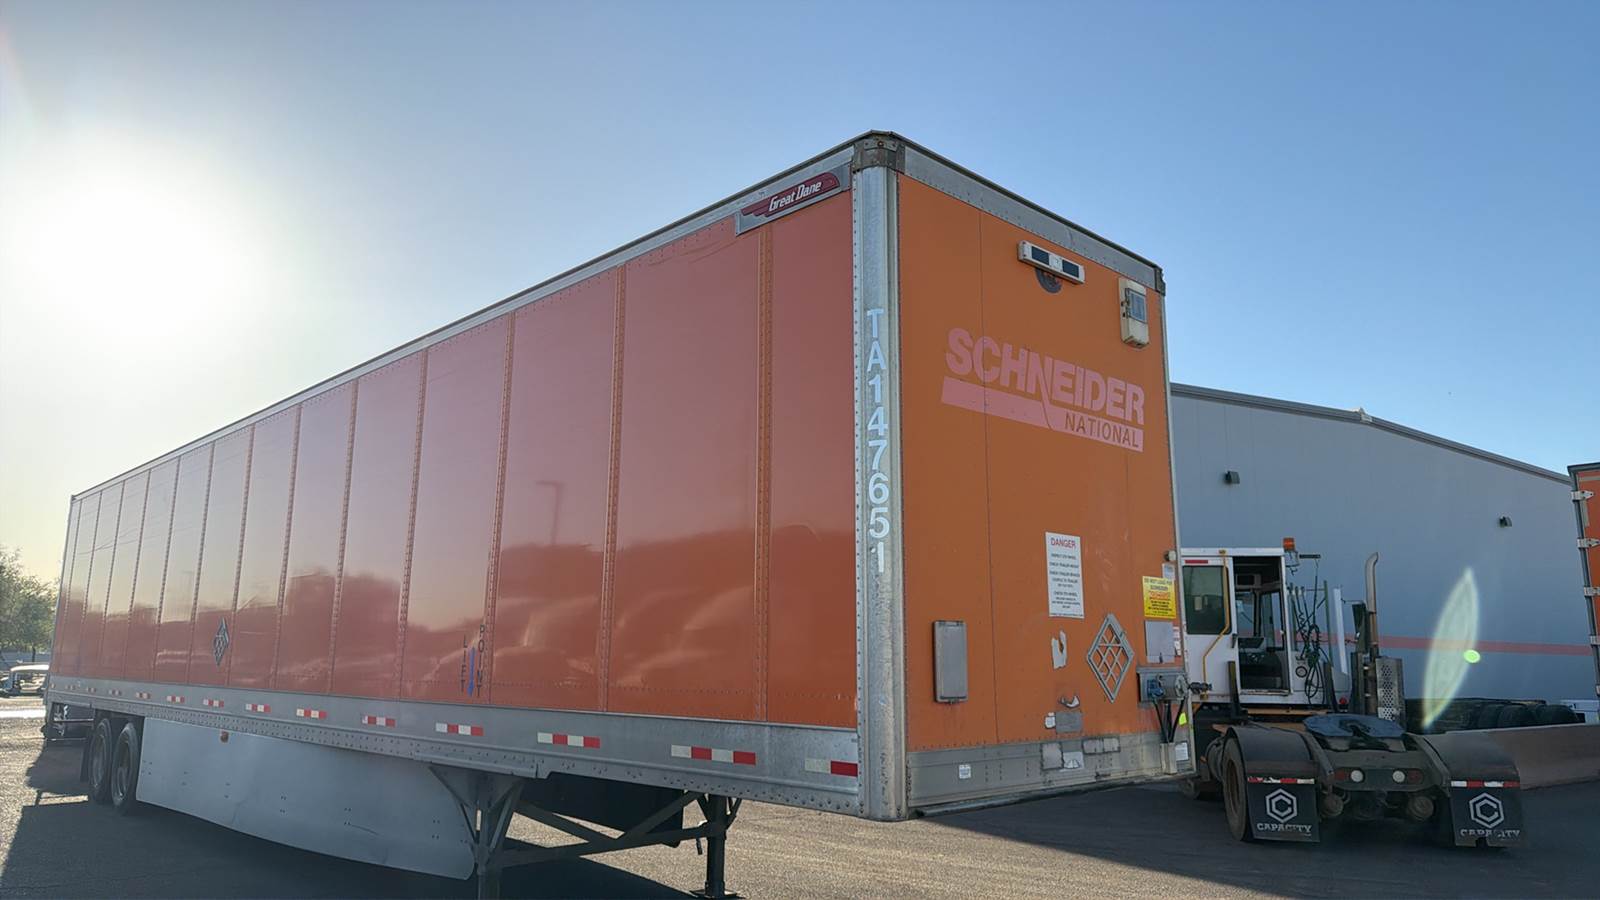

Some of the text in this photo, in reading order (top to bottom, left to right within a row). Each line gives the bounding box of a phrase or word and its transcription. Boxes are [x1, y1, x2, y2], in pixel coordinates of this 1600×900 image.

[768, 182, 822, 212] Great Dane
[945, 327, 1145, 426] SCHNEIDER
[866, 308, 890, 573] TA147651
[1064, 413, 1140, 448] NATIONAL
[1050, 537, 1077, 549] DANGER
[477, 624, 486, 698] POINT
